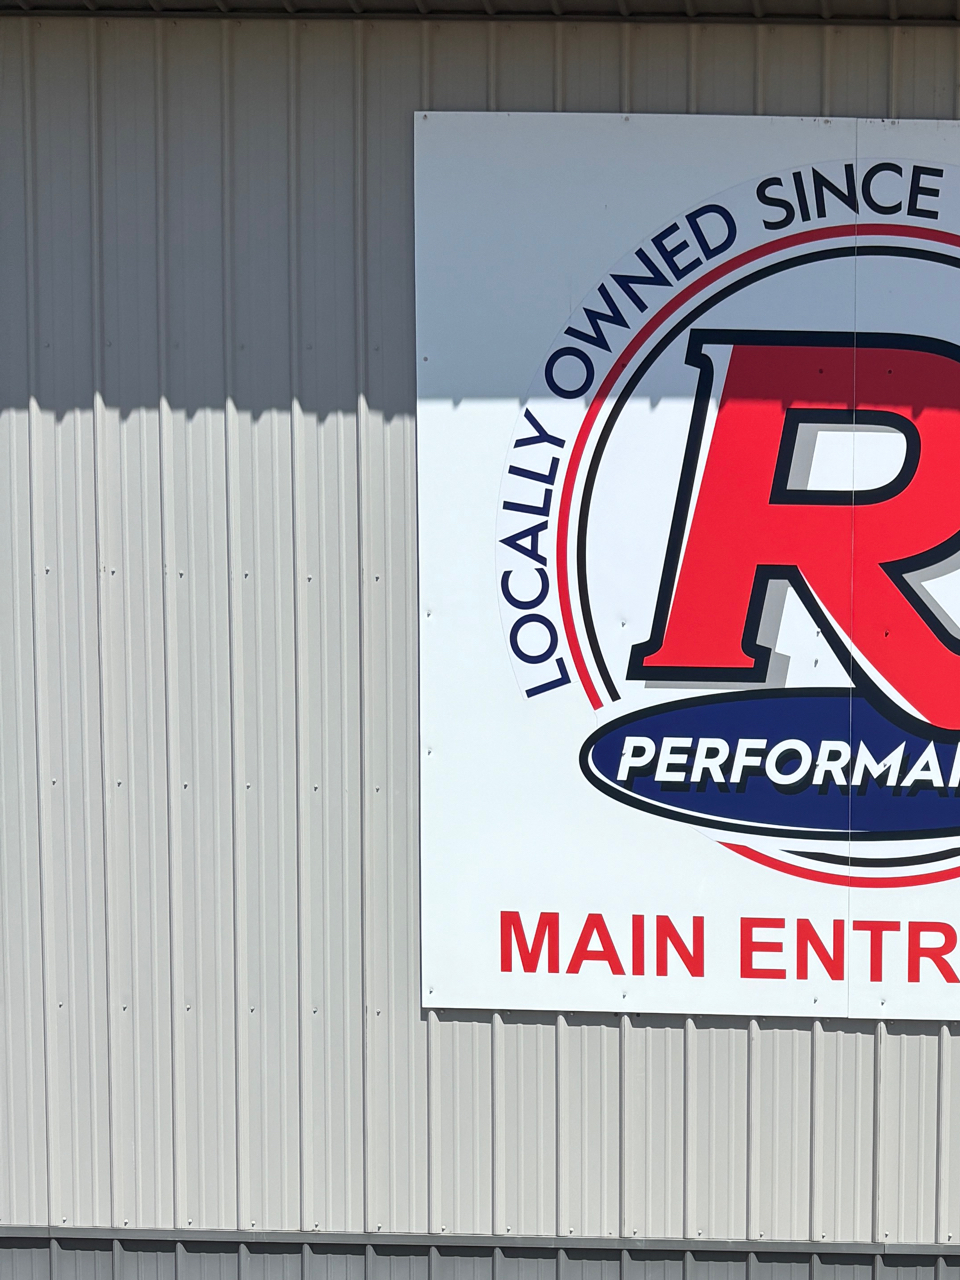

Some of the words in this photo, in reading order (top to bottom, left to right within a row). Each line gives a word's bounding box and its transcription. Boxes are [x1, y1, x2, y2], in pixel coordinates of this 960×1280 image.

[499, 407, 571, 698] LOCALLY
[544, 204, 738, 400] OWNED
[755, 162, 945, 231] SINCE
[500, 910, 705, 978] MAIN
